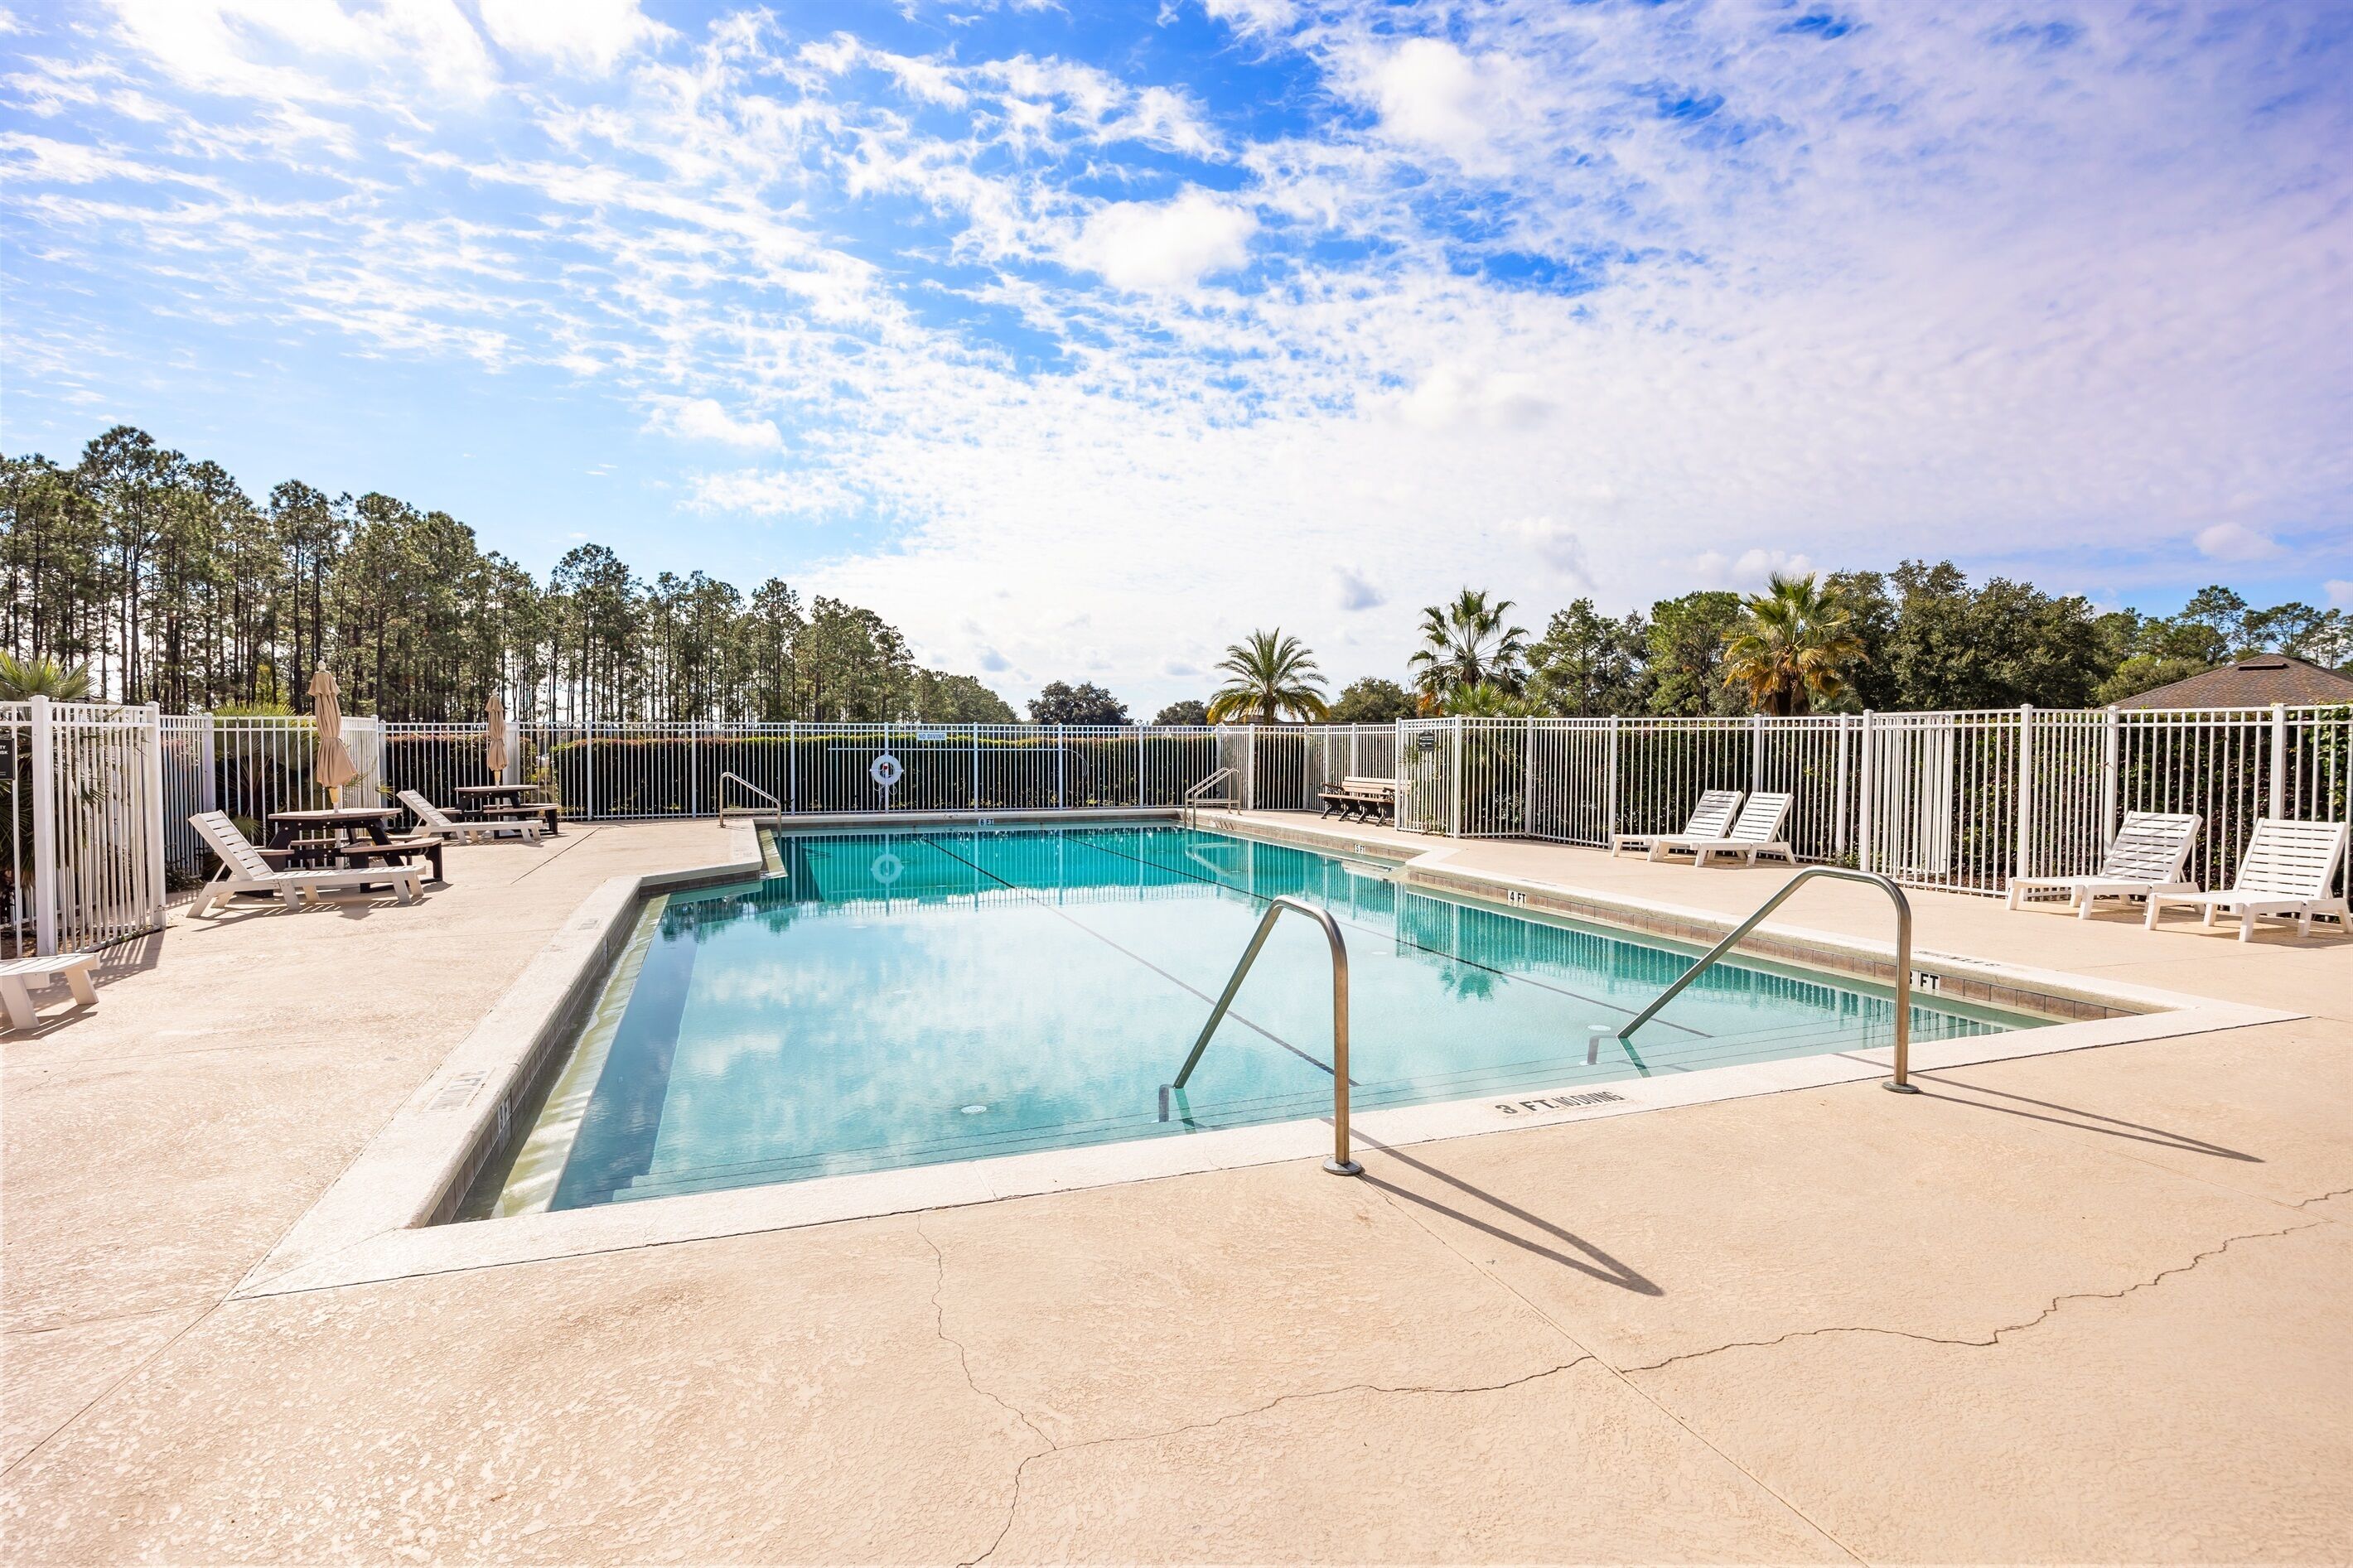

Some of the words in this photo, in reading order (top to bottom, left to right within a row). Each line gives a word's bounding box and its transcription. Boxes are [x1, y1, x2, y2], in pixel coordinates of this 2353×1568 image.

[1510, 891, 1515, 901] 4
[1517, 892, 1525, 903] FT
[1920, 972, 1939, 990] FT
[1495, 1104, 1519, 1114] 3
[1551, 1097, 1581, 1107] NO
[1569, 1091, 1626, 1105] DIVING
